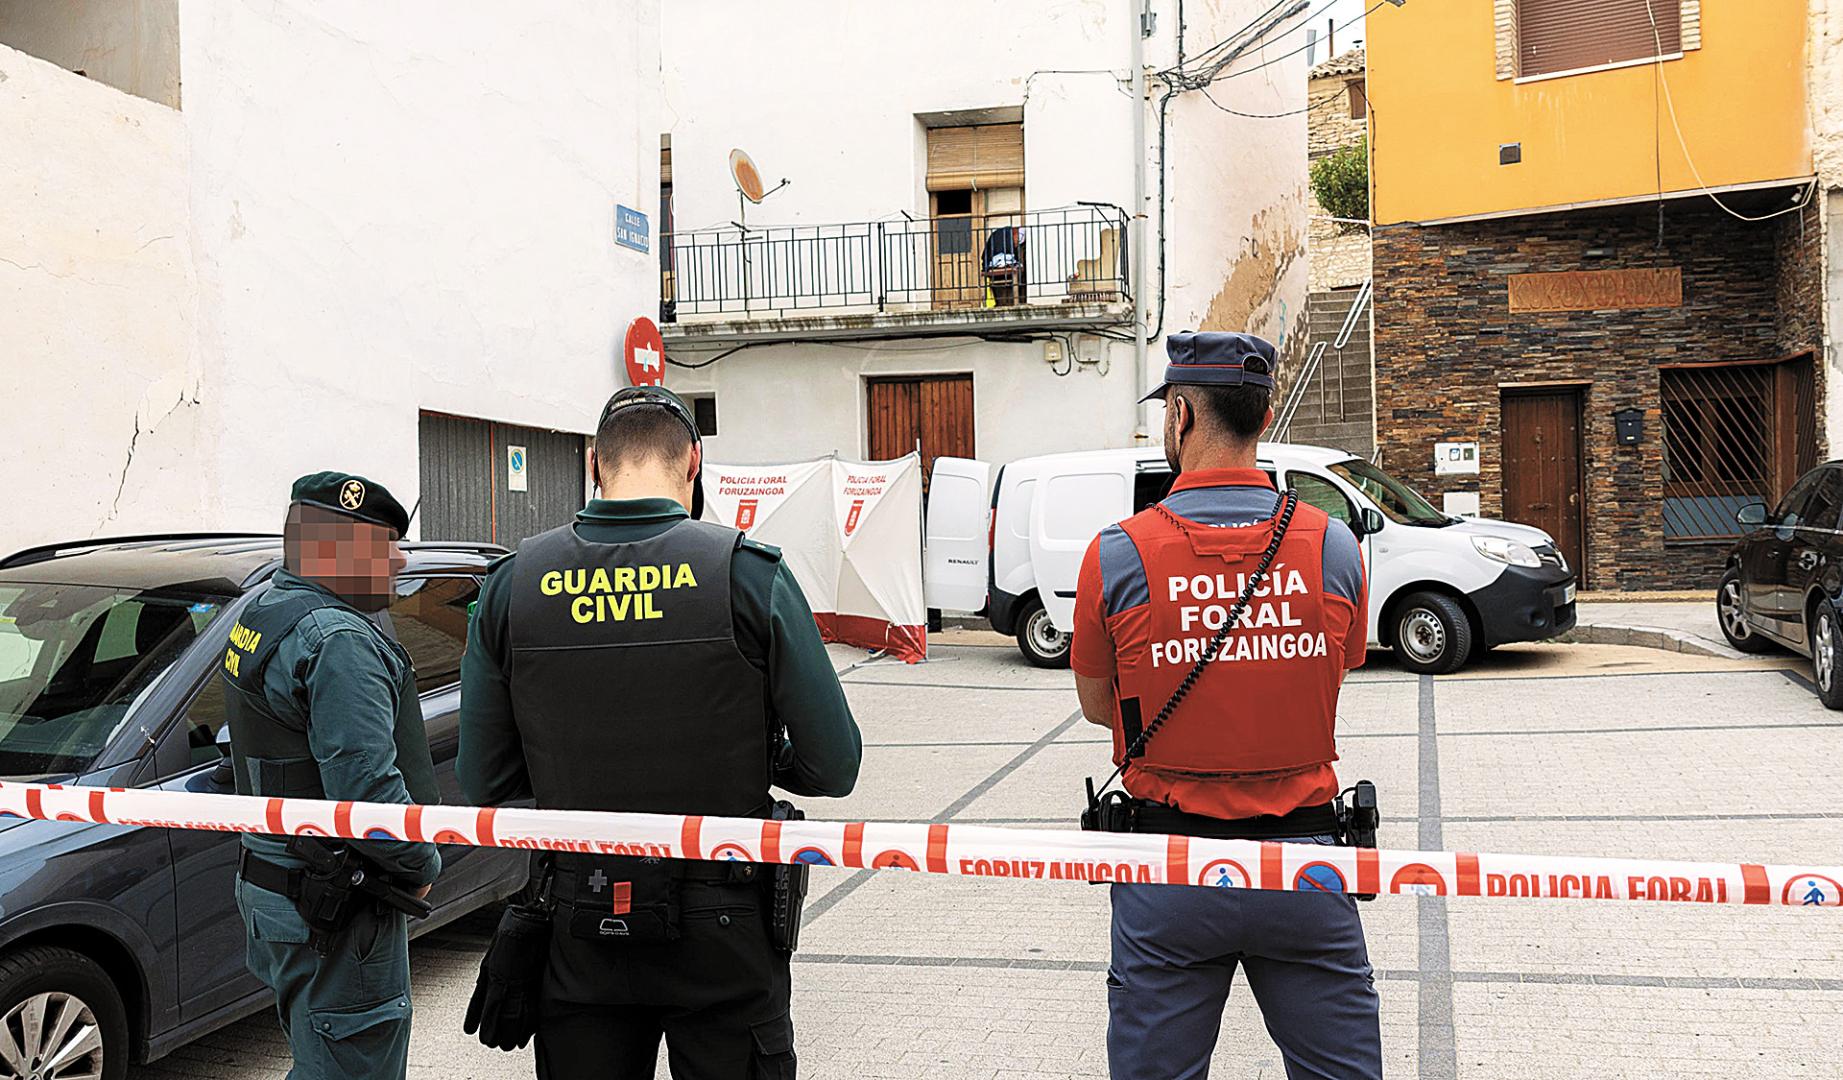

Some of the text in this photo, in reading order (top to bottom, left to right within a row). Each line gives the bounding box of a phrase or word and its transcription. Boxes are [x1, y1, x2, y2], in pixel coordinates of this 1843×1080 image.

[719, 487, 784, 495] FORUZAINGOA
[757, 475, 787, 484] FORAL
[540, 563, 698, 596] GUARDIA
[1168, 563, 1308, 601] POLICÍA
[571, 593, 663, 624] CIVIL
[1180, 602, 1302, 631] FORAL
[1151, 632, 1327, 668] FORUZAINGOA
